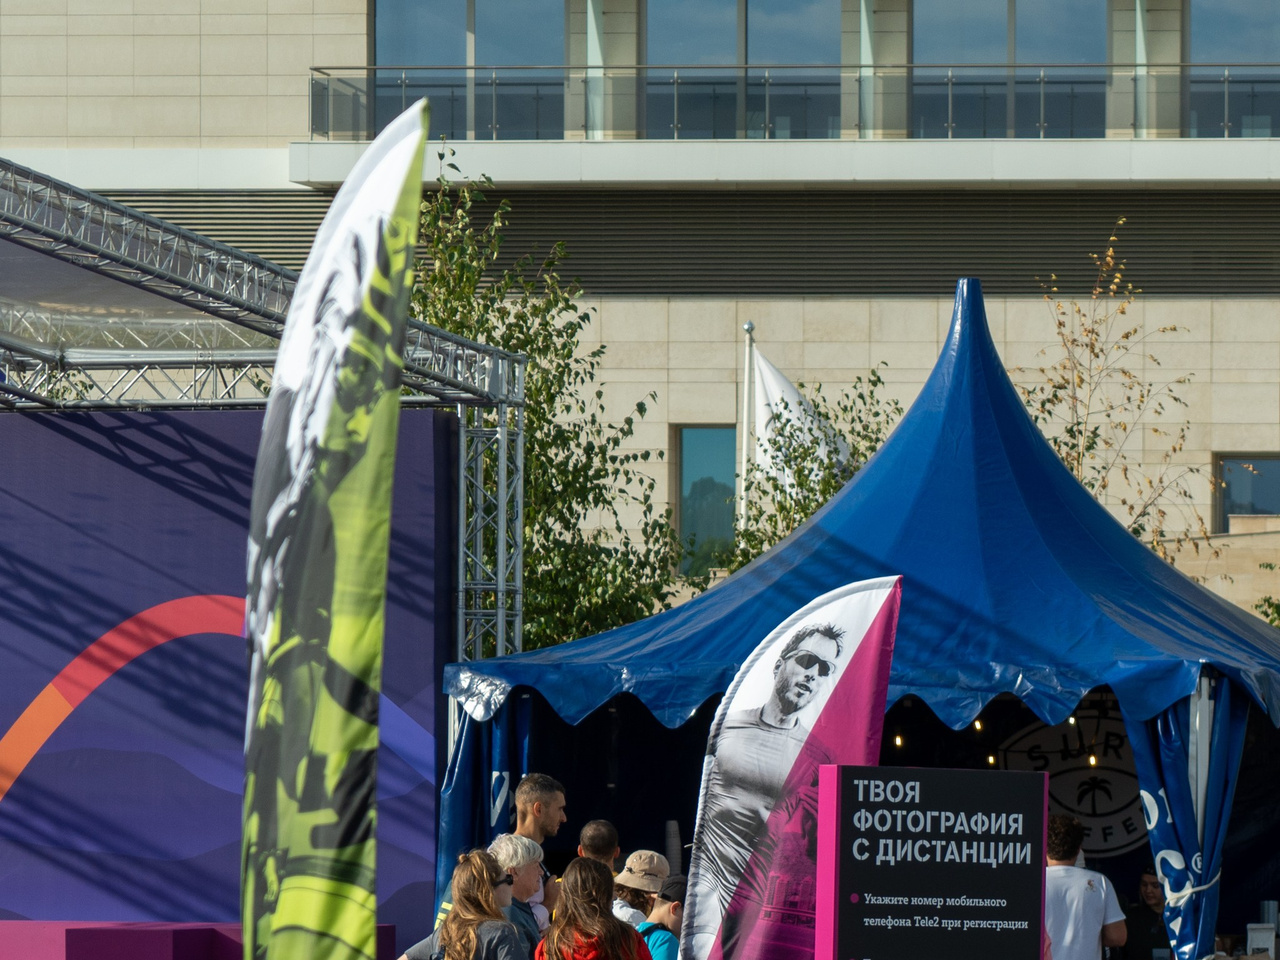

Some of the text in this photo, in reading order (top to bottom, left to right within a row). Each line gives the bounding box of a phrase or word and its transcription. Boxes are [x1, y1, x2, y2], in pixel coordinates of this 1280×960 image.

[854, 780, 920, 803] ТВОЯ
[853, 809, 1024, 835] ФОТОГРАФИЯ
[852, 838, 1032, 869] С ДИСТАНЦИИ
[864, 893, 1007, 909] Укажите номер мобильного
[864, 915, 1029, 932] телефона Tele2 при регистрации
